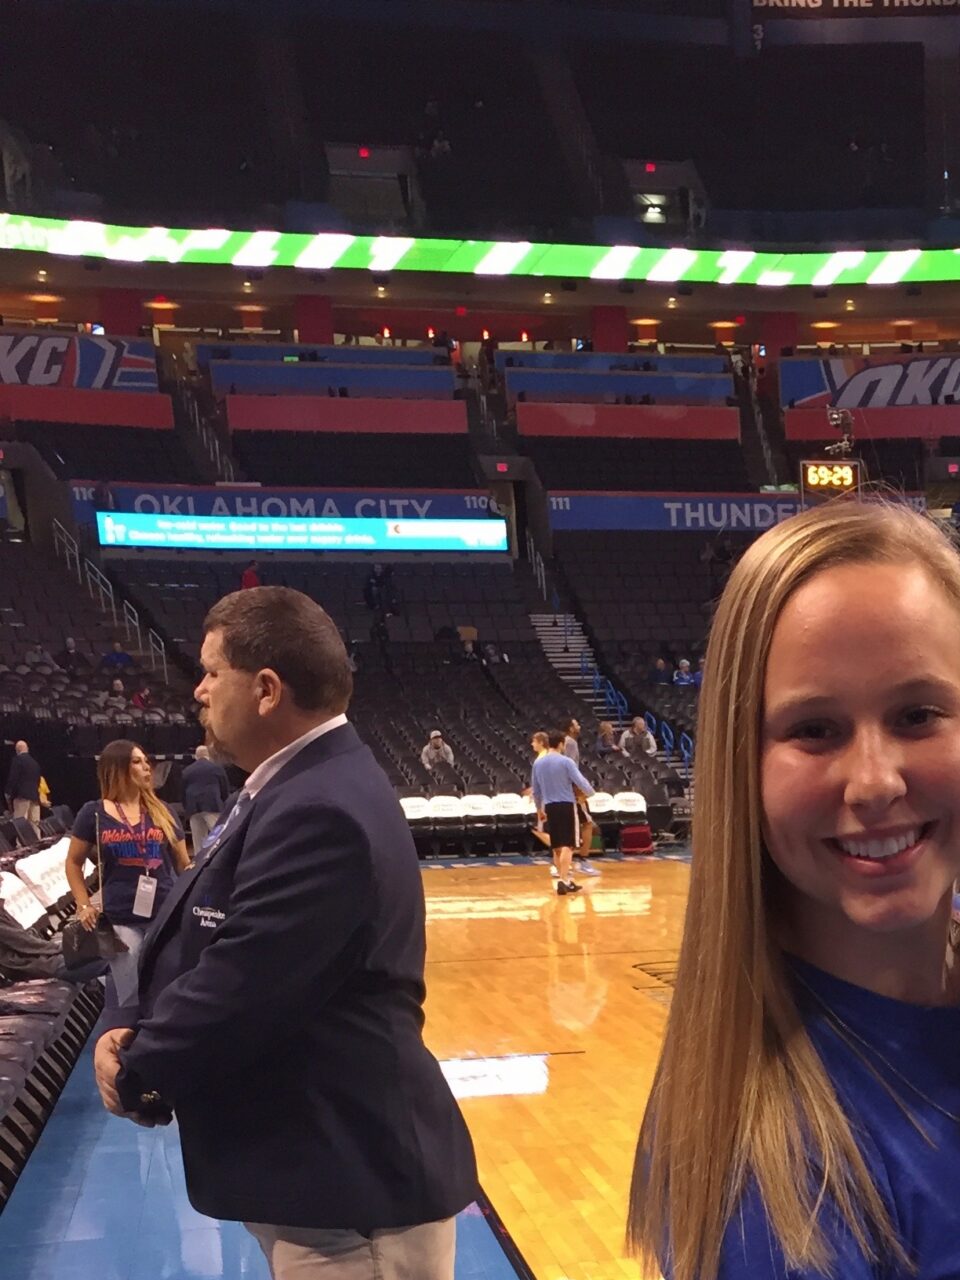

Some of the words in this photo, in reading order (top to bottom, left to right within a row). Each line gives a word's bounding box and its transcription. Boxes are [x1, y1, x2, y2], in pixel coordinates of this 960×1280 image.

[0, 335, 69, 386] KC
[134, 493, 341, 517] OKLAHOMA
[354, 498, 432, 519] CITY
[664, 502, 808, 528] THUNDE
